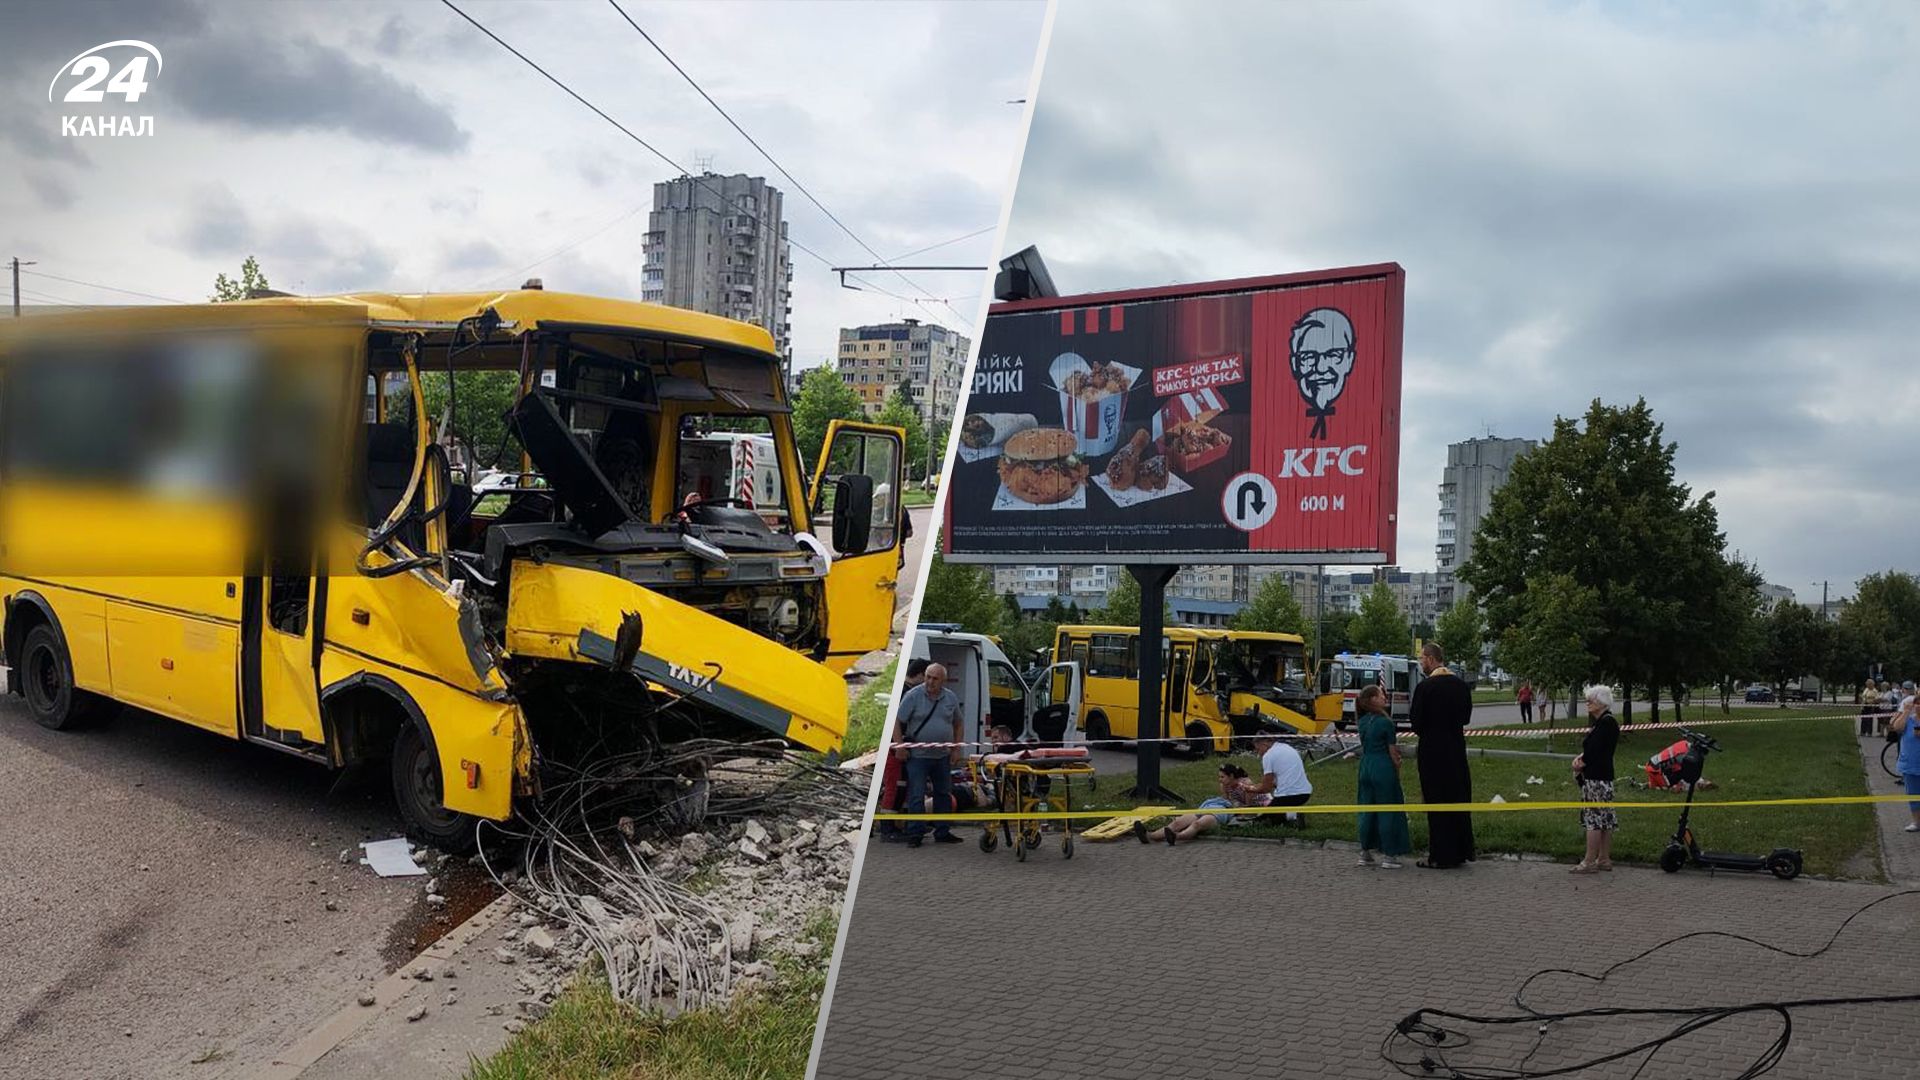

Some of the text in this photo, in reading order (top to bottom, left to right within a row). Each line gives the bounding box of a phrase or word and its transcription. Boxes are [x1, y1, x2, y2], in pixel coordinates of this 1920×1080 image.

[969, 369, 1023, 395] РІЯКІ
[1191, 370, 1241, 388] КУРКА
[1278, 444, 1367, 478] KFC
[1300, 495, 1328, 512] 600
[668, 661, 714, 693] TATA
